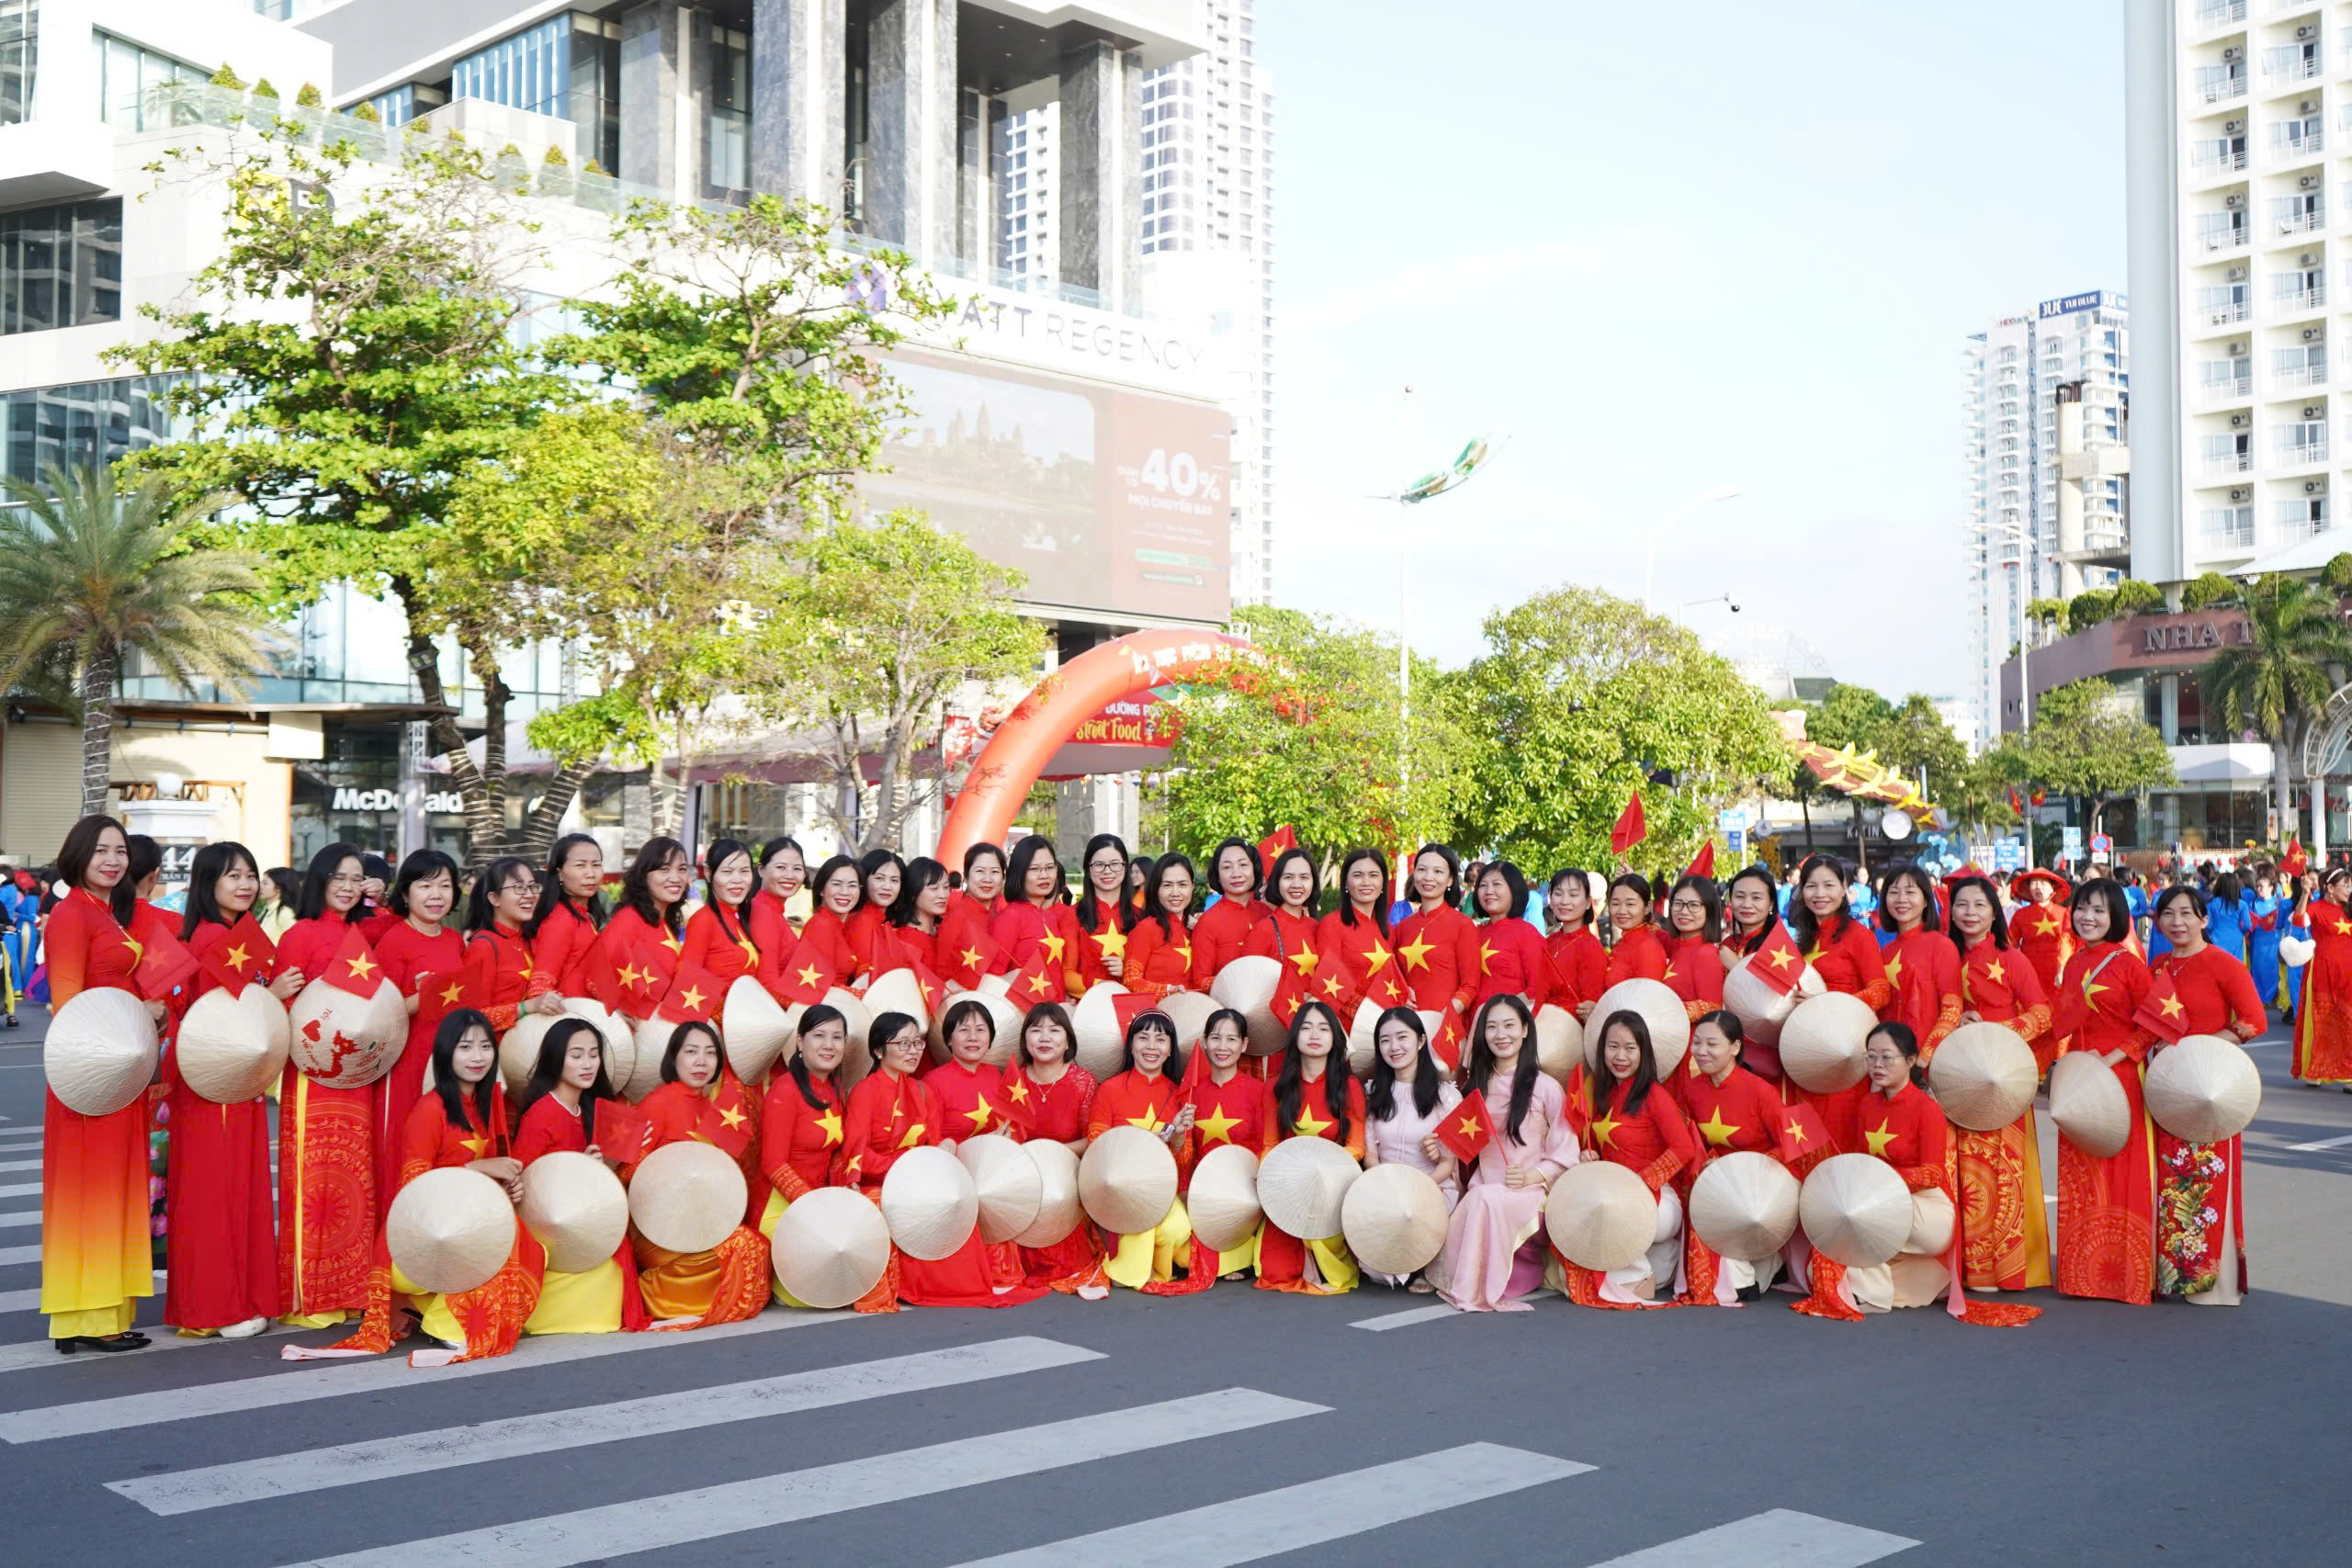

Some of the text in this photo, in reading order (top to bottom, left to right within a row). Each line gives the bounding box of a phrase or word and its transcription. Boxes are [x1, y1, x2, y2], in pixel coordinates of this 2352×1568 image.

[1047, 313, 1203, 369] REGENCY
[1140, 448, 1221, 502] 40%
[2144, 620, 2222, 651] NHA
[1111, 716, 1142, 741] Food
[162, 846, 197, 872] 44
[321, 1008, 333, 1021] TÔI
